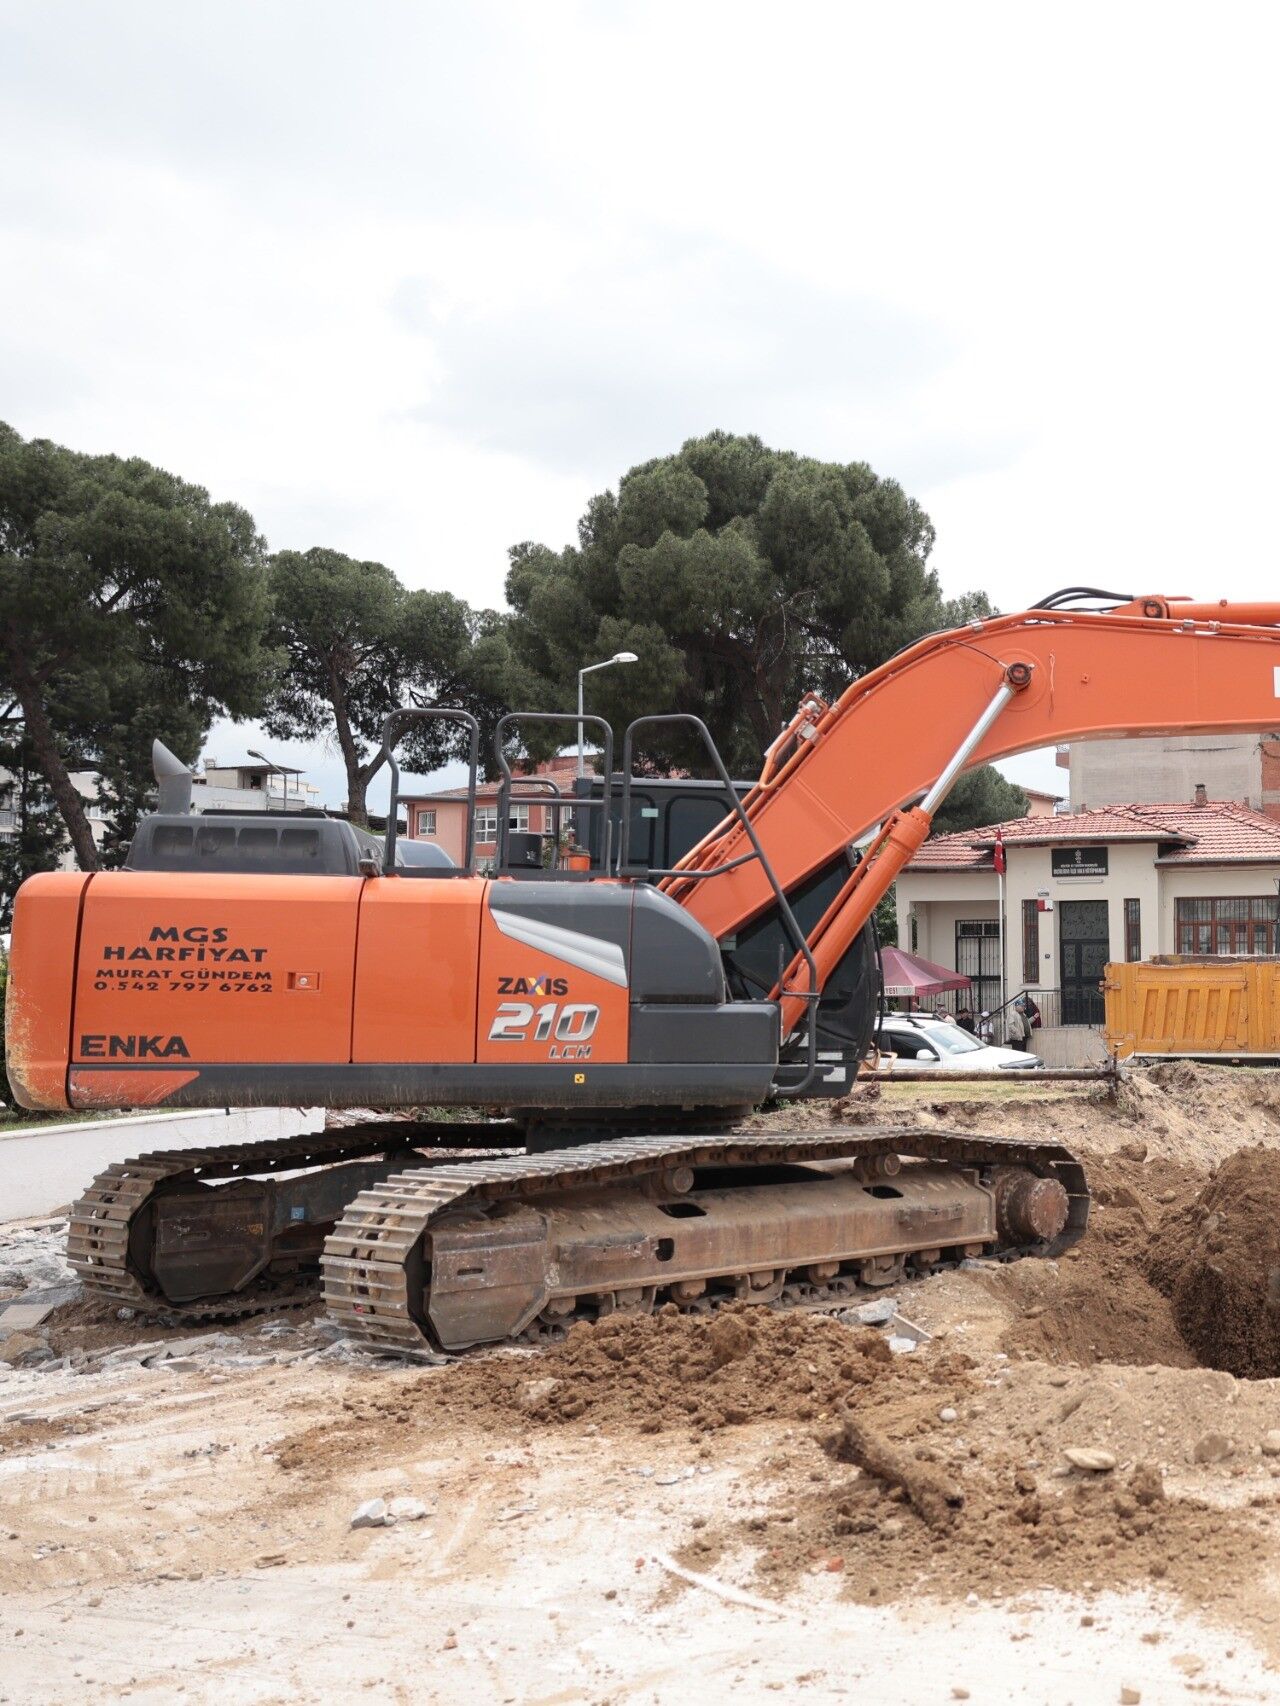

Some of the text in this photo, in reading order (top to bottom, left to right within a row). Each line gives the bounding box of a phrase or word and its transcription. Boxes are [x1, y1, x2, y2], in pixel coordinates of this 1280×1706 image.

[149, 926, 228, 943] MGS
[103, 944, 268, 962] HARFİYAT
[96, 968, 272, 980] MURAT GÜNDEM
[94, 981, 273, 993] 0.542 797 6762
[497, 976, 568, 996] ZAXIS
[487, 1002, 600, 1041] 210
[80, 1035, 191, 1058] ENKA
[548, 1045, 592, 1059] LCH
